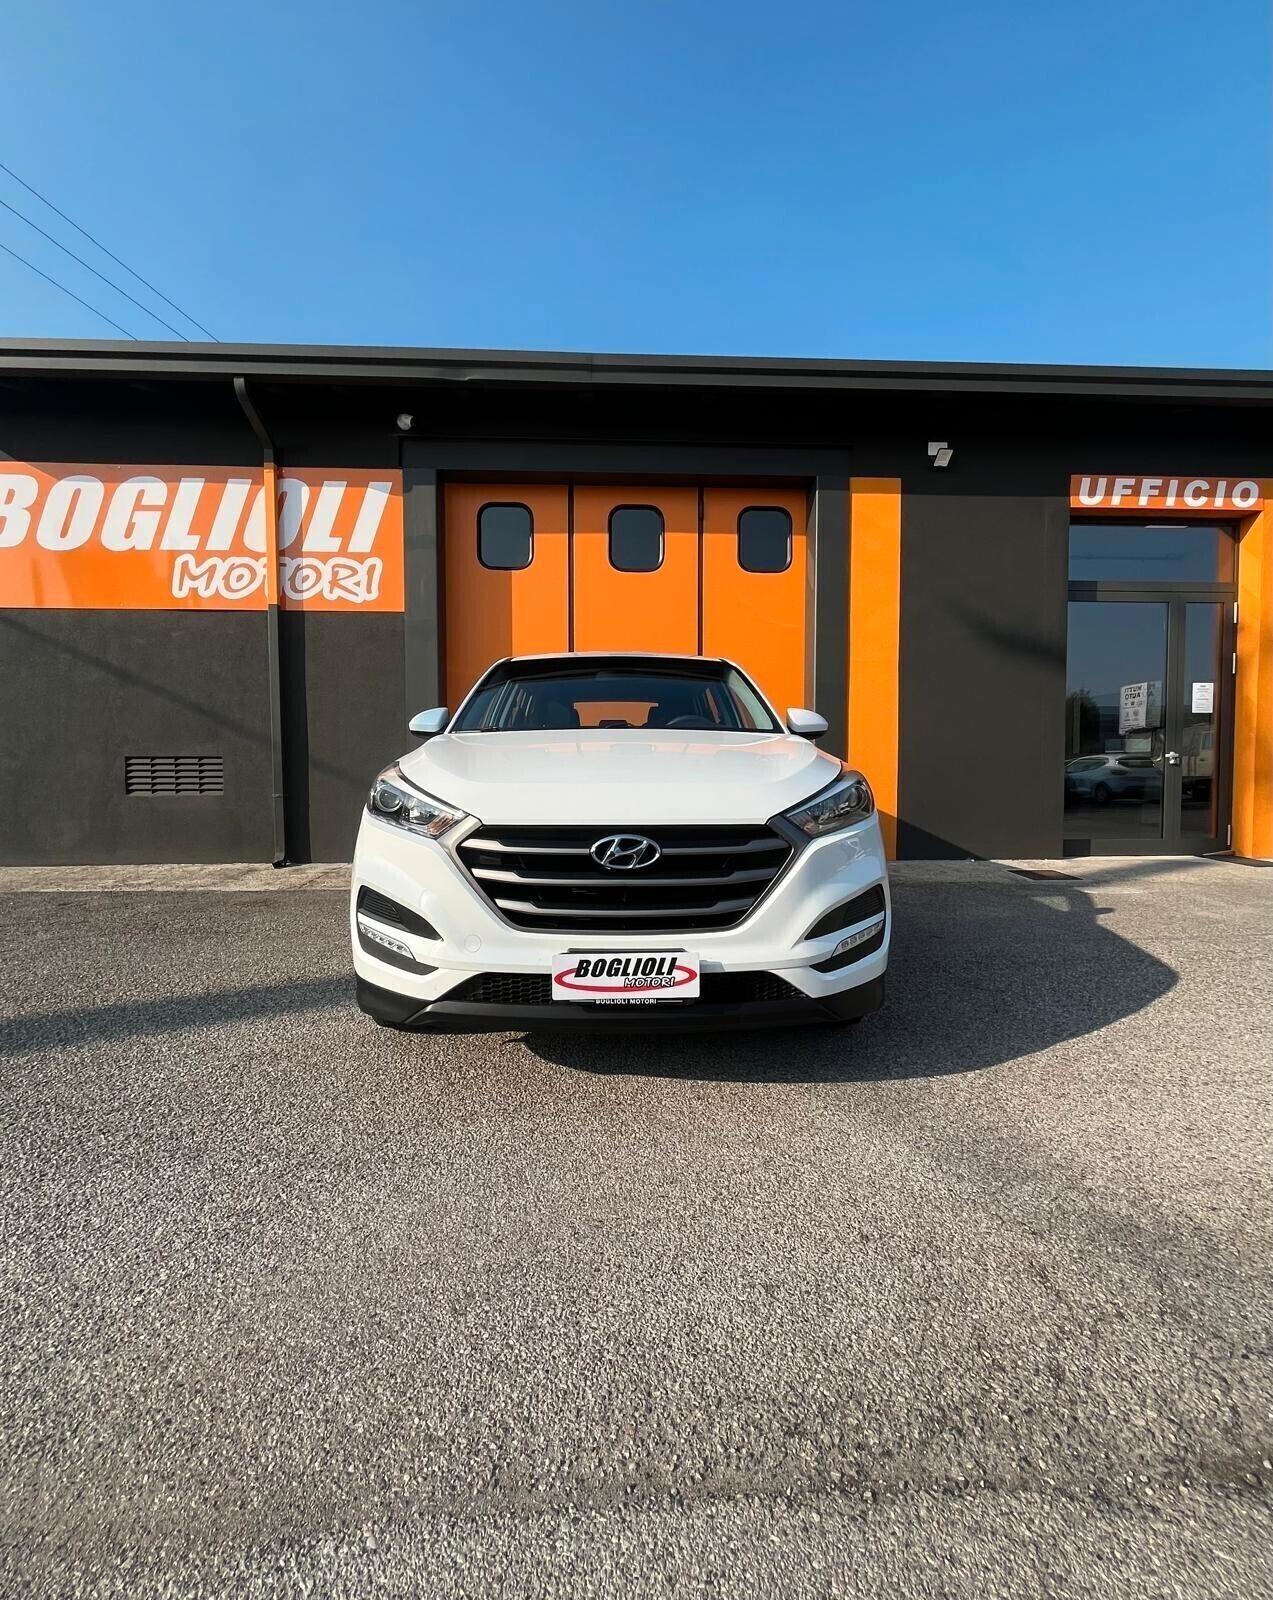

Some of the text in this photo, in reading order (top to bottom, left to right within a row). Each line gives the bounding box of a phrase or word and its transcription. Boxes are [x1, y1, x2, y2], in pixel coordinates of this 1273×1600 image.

[1079, 477, 1259, 508] UFFICIO
[0, 474, 392, 553] BOGLIOLI
[172, 553, 383, 604] MOORI
[574, 957, 678, 978] BOGLIOLI
[624, 977, 675, 988] MOTORI
